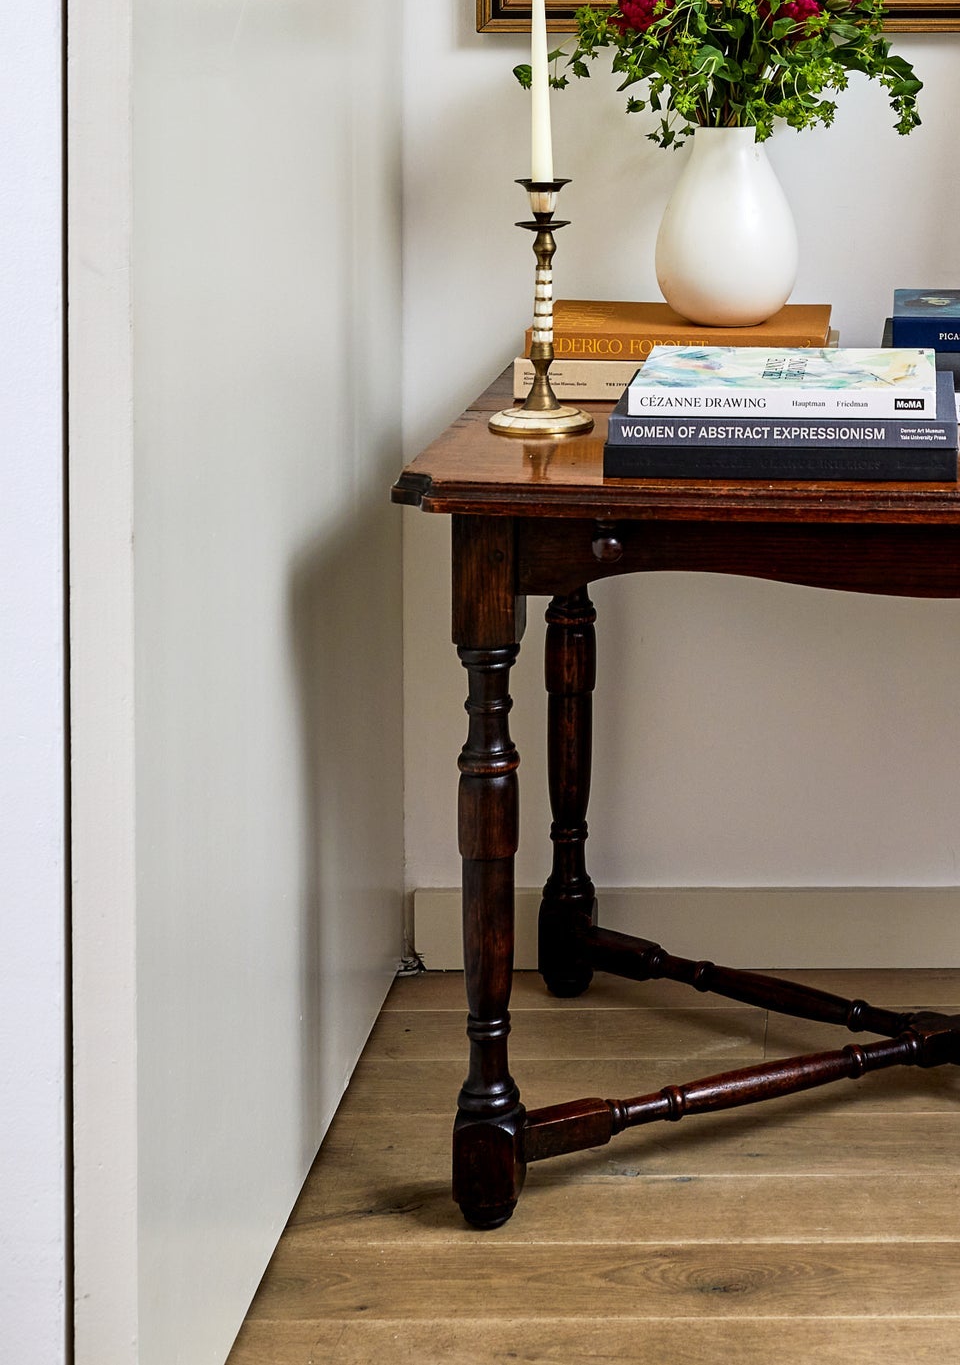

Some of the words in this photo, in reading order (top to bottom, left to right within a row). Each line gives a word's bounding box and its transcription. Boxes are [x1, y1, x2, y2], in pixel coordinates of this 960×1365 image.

[553, 338, 622, 354] EDERICO
[639, 394, 702, 408] CÉZANNE
[705, 397, 767, 408] DRAWING
[792, 400, 826, 409] Hauptman
[836, 400, 869, 408] Friedman
[896, 400, 923, 409] MoMA
[620, 425, 674, 438] WOMEN
[677, 426, 697, 439] OF
[698, 426, 771, 439] ABSTRACT
[774, 426, 886, 440] EXPRESSIONISM
